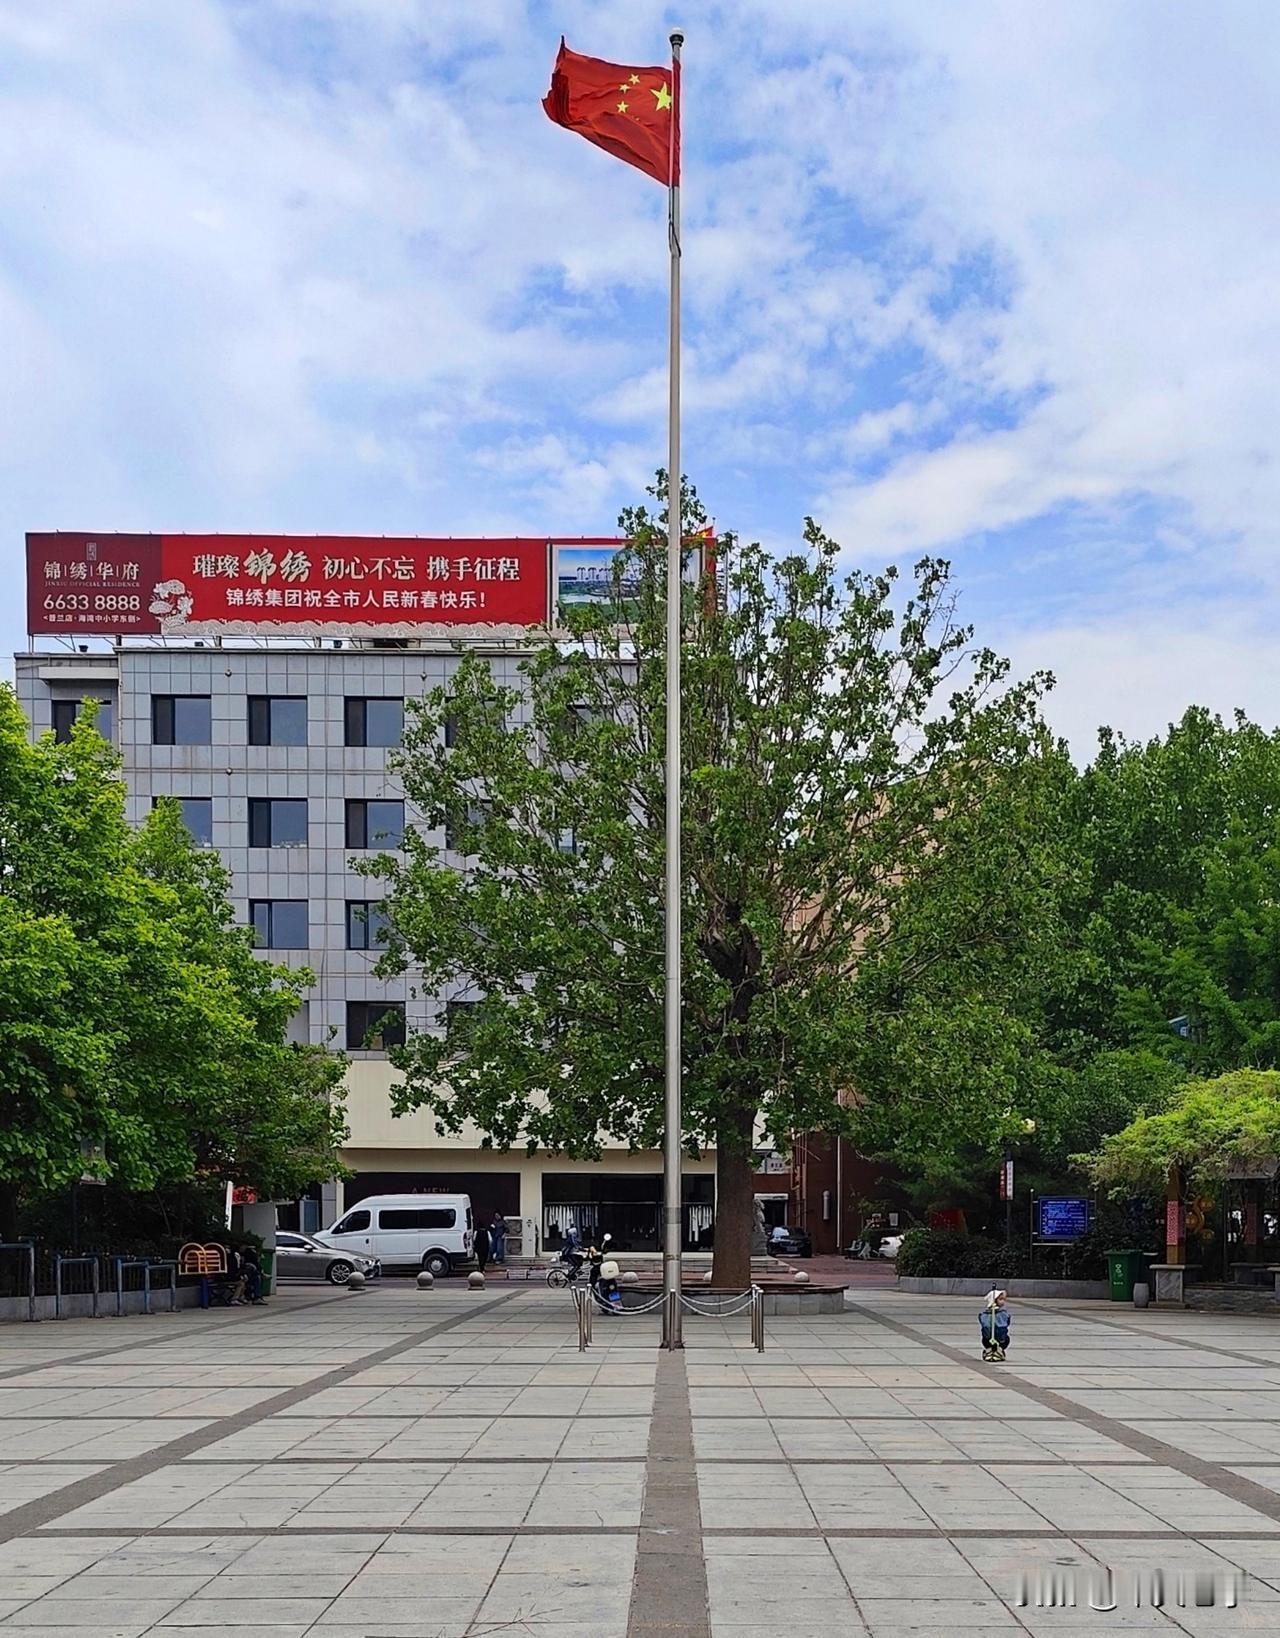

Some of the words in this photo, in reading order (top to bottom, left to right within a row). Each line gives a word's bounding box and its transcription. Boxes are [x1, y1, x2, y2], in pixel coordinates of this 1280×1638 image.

[322, 555, 415, 581] 初心不忘
[427, 556, 520, 581] 携手征程
[43, 594, 89, 610] 6633
[94, 594, 140, 611] 8888
[226, 587, 487, 609] 锦绣集团祝全市人民新春快乐!
